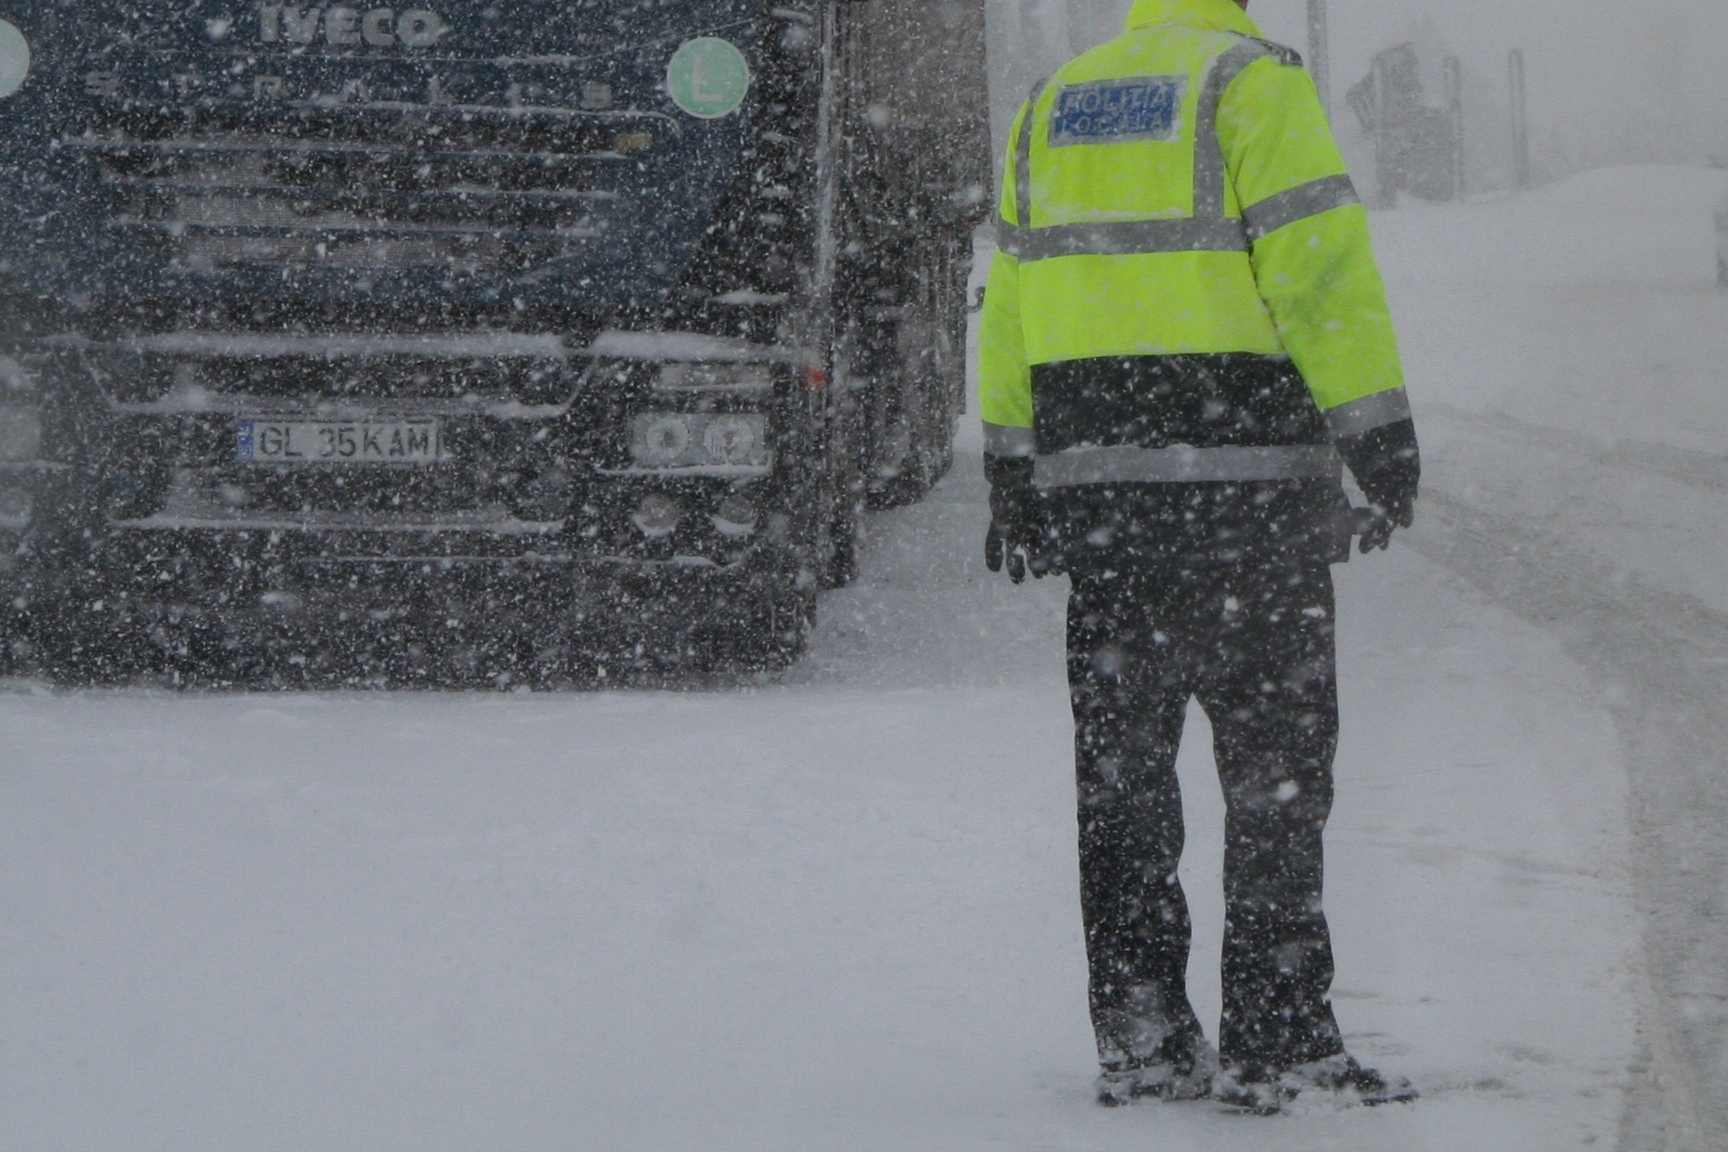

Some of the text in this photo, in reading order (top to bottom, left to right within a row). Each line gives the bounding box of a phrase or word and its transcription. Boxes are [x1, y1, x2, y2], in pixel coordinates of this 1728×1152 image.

[259, 5, 444, 47] IVECO
[259, 426, 303, 457] GL
[318, 426, 357, 457] 35
[362, 426, 429, 458] KAM
